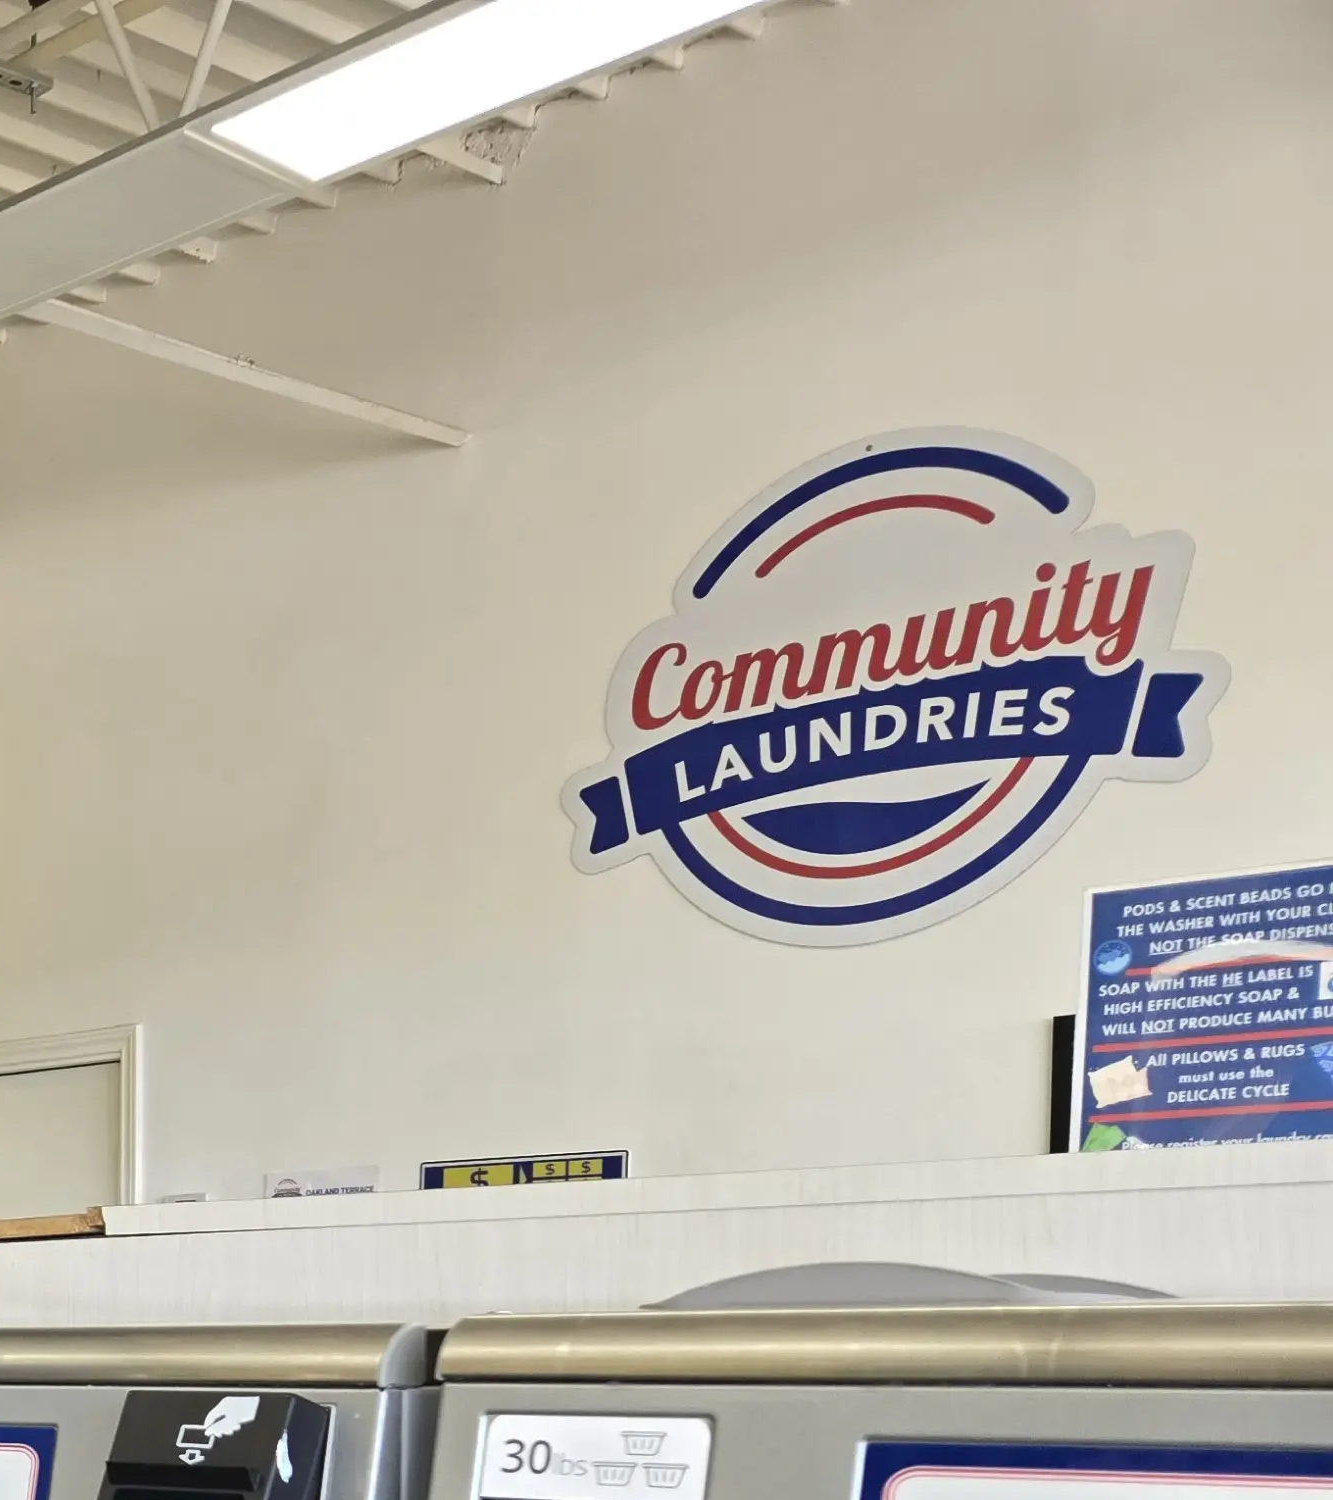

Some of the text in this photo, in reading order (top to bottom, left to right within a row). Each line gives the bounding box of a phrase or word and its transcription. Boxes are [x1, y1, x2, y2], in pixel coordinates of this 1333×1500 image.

[632, 561, 1155, 734] Community
[675, 686, 1076, 803] LAUNDRIES
[1123, 884, 1324, 918] PODS & SCENT BEADS GO
[1117, 924, 1144, 938] THE
[1149, 917, 1214, 935] WASHER
[1219, 911, 1260, 927] WITH
[1266, 904, 1312, 922] YOUR
[1150, 940, 1183, 954] NOT
[1187, 936, 1215, 951] THE
[1221, 931, 1265, 946] SOAP
[1099, 965, 1313, 997] SOAP WITH THE HE LABEL IS
[1104, 987, 1300, 1016] HIGH EFFICIENCY SOAP &
[1102, 1023, 1136, 1036] WILL
[1141, 1019, 1174, 1032] NOT
[1179, 1012, 1252, 1030] PRODUCE
[1257, 1007, 1308, 1023] MANY
[1172, 1050, 1238, 1066] PILLOWS
[1243, 1048, 1255, 1060] &
[1260, 1043, 1306, 1058] RUGS
[1178, 1065, 1274, 1083] must use the
[1167, 1083, 1289, 1103] DELICATE CYCLE
[306, 1185, 374, 1196] OAKLAND TERRACE
